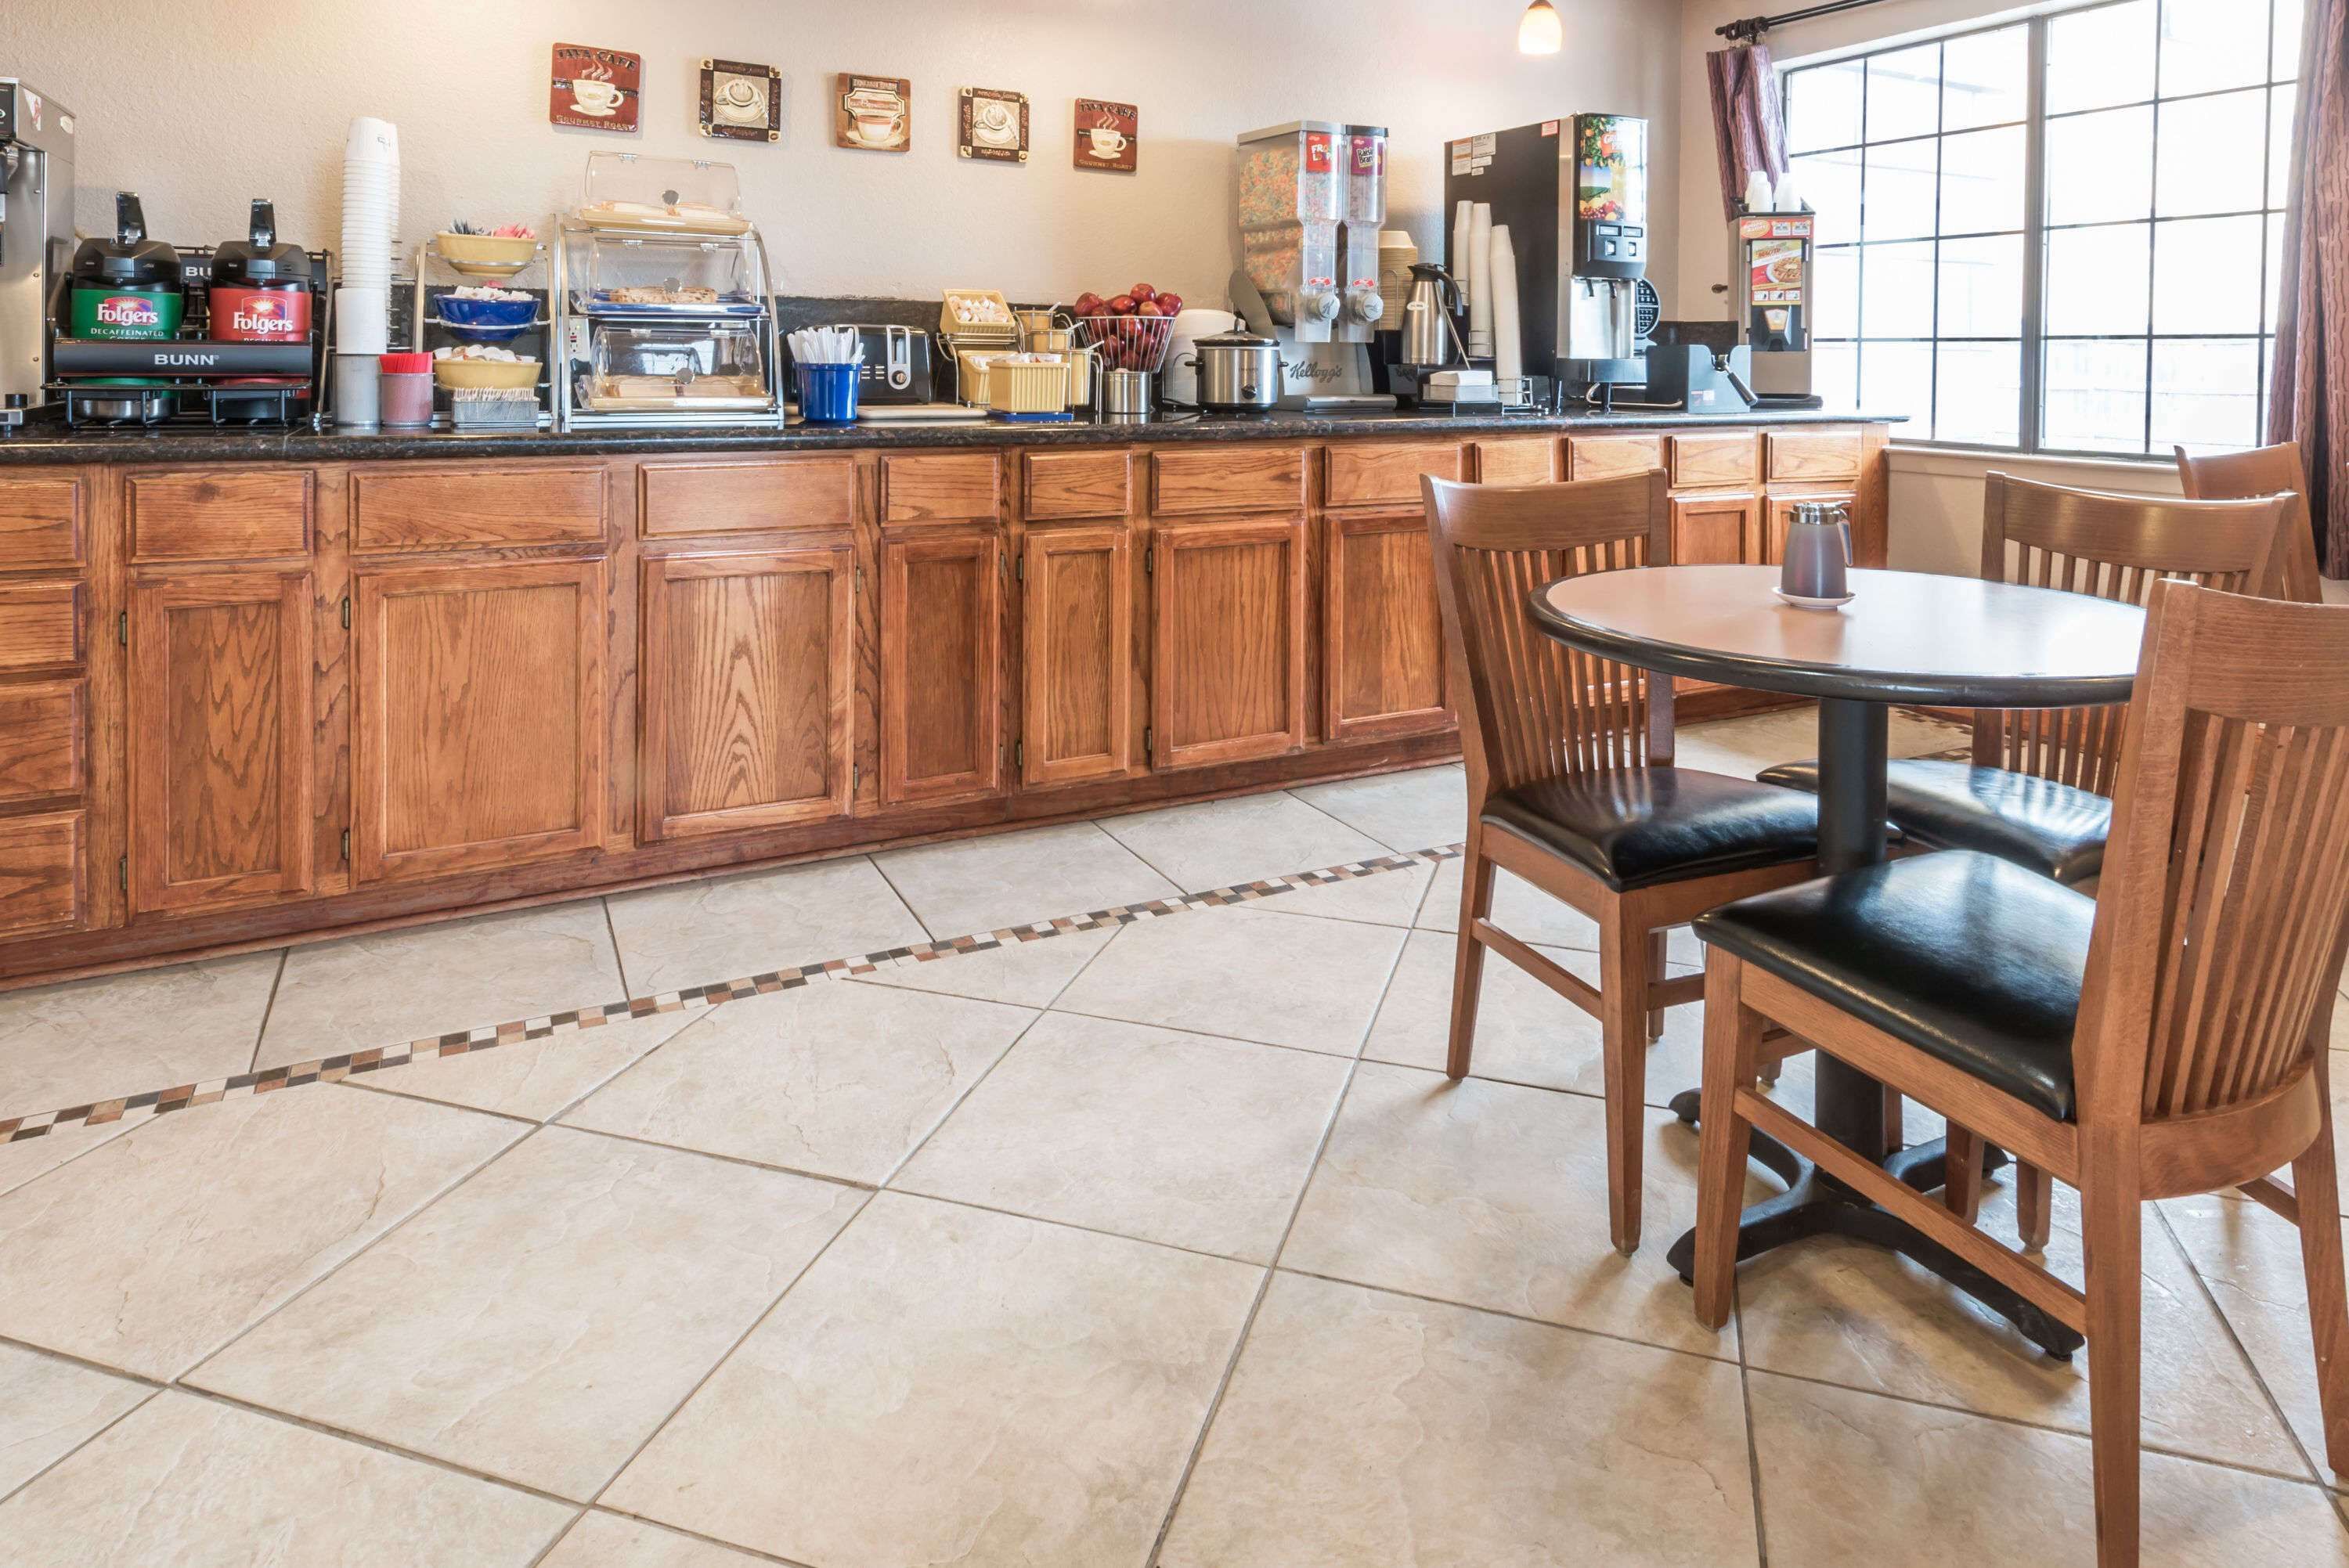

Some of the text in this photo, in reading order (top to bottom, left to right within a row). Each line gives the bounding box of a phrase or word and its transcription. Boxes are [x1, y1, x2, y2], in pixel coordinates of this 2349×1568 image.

[556, 49, 592, 61] JAVA
[96, 303, 158, 326] Folgers
[233, 312, 294, 334] Folgers
[90, 327, 164, 337] DECAFFEINATED
[1290, 360, 1342, 383] Kellogg's
